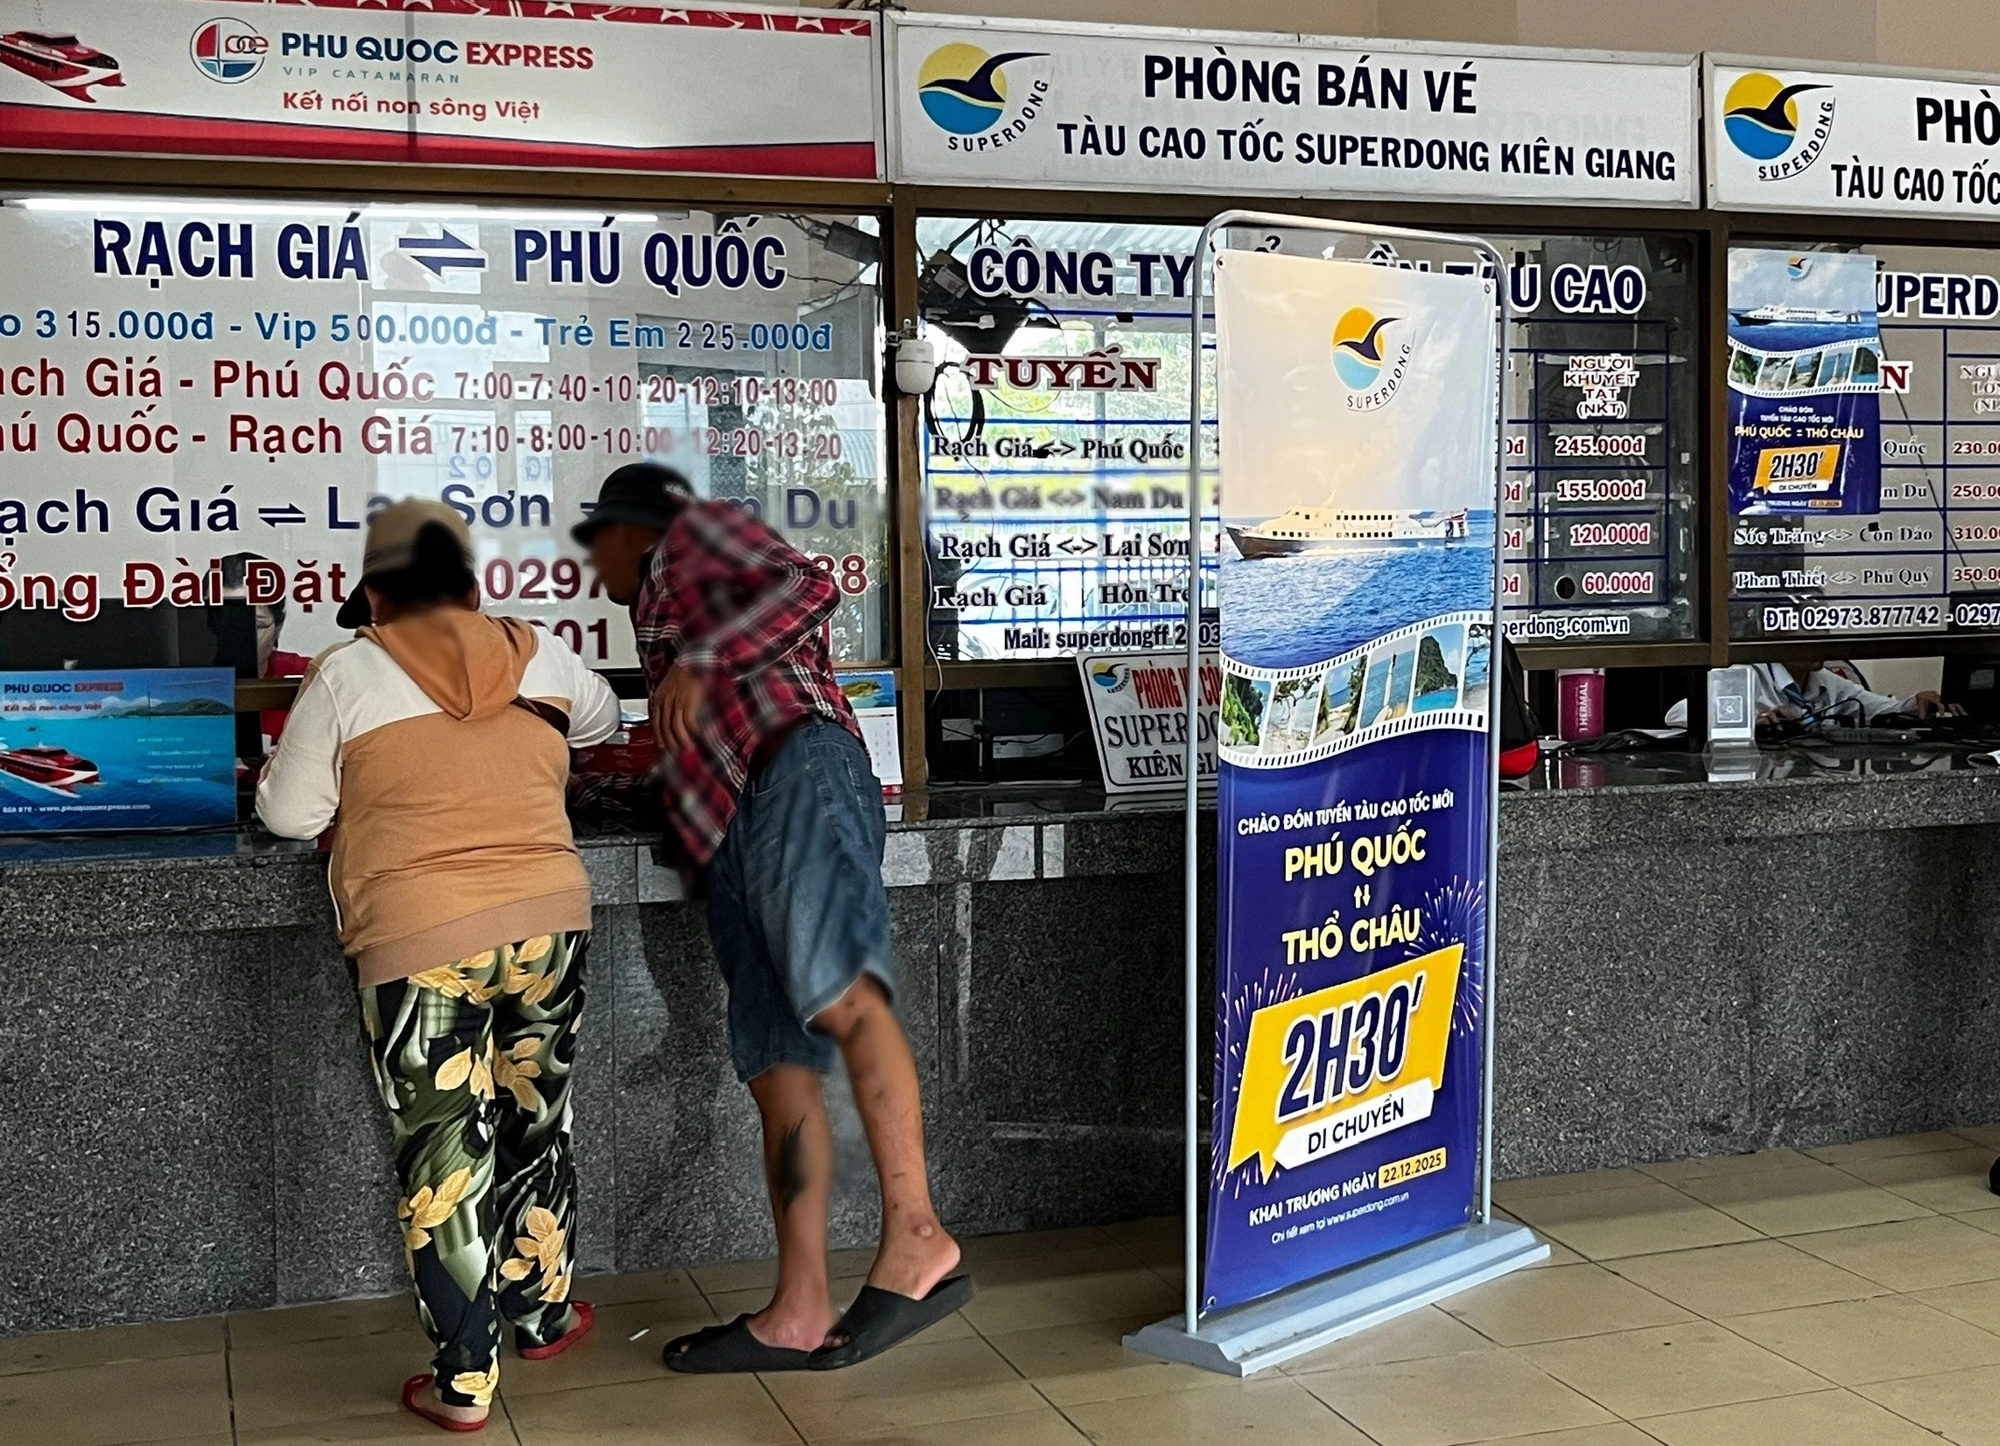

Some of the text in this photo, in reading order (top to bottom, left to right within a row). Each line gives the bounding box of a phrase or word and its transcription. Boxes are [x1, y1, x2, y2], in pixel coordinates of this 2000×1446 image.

[281, 32, 594, 69] PHU QUOC EXPRESS
[282, 66, 460, 84] VIP CATAMARAN
[1144, 46, 1477, 114] PHÒNG BÁN VÉ
[283, 90, 541, 124] Kết nối non sông Việt
[947, 78, 1049, 153] SUPERDONG
[1915, 88, 2000, 146] PHÒ
[1057, 115, 1676, 182] TÀU CAO TỐC SUPERDONG KIÊN GIANG
[1758, 100, 1834, 180] SUPERDONG
[1831, 155, 2000, 205] TÀU CAO TỐC
[93, 210, 786, 296] RẠCH GIÁ PHÚ QUỐC
[970, 237, 1194, 298] CÔNG TY
[1553, 266, 1643, 311] CAO
[1876, 273, 1999, 316] UPERD
[255, 311, 317, 348] Vip
[331, 313, 498, 346] 500.000đ
[535, 315, 593, 348] Trẻ
[610, 320, 664, 347] Em
[86, 356, 162, 398] Giá
[213, 359, 298, 398] Phú
[318, 356, 436, 403] Quốc
[965, 346, 1158, 389] TUYẾN
[1347, 343, 1411, 409] SUPERDONG
[57, 404, 179, 454] Quốc
[229, 414, 342, 463] Rạch
[361, 415, 433, 455] Giá
[932, 434, 1185, 466] Rạch Giá Phú Quốc
[1556, 438, 1643, 455] 245.000đ
[1734, 424, 1757, 437] PHÚ
[1953, 442, 2000, 454] 230.0
[785, 488, 856, 530] Du
[1557, 481, 1643, 498] 155.000đ
[1904, 484, 1927, 498] Du
[1952, 485, 2000, 497] 250.0
[940, 534, 1001, 564] Rạch
[1009, 534, 1051, 558] Giá
[1103, 534, 1141, 562] Lại
[1149, 534, 1190, 557] Sơn
[1571, 525, 1648, 544] 120.000đ
[1954, 527, 2000, 540] 310.0
[123, 557, 223, 606] Đài
[245, 559, 347, 613] Đặt
[1005, 584, 1048, 606] Giá
[1100, 584, 1148, 604] Hòn
[1584, 575, 1651, 592] 60.000đ
[1953, 568, 2000, 581] 350.0
[1004, 627, 1050, 649] Mail:
[1765, 608, 1798, 628] ĐT:
[1803, 606, 1939, 627] 02973.877742
[4, 683, 72, 694] PHU QUOC
[1131, 660, 1183, 710] PHÒNG
[1578, 682, 1589, 733] THERMAL
[1125, 748, 1184, 778] KIÊN
[1237, 788, 1454, 836] CHÀO ĐÓN TUYẾN TÀU CAO TỐC MỚI
[1285, 819, 1427, 882] PHÚ QUỐC
[1281, 903, 1422, 966] THỔ CHÂU
[1307, 1093, 1405, 1155] DI CHUYỂN
[1249, 1154, 1442, 1227] KHAI TRƯƠNG NGÀY 22.12.2025
